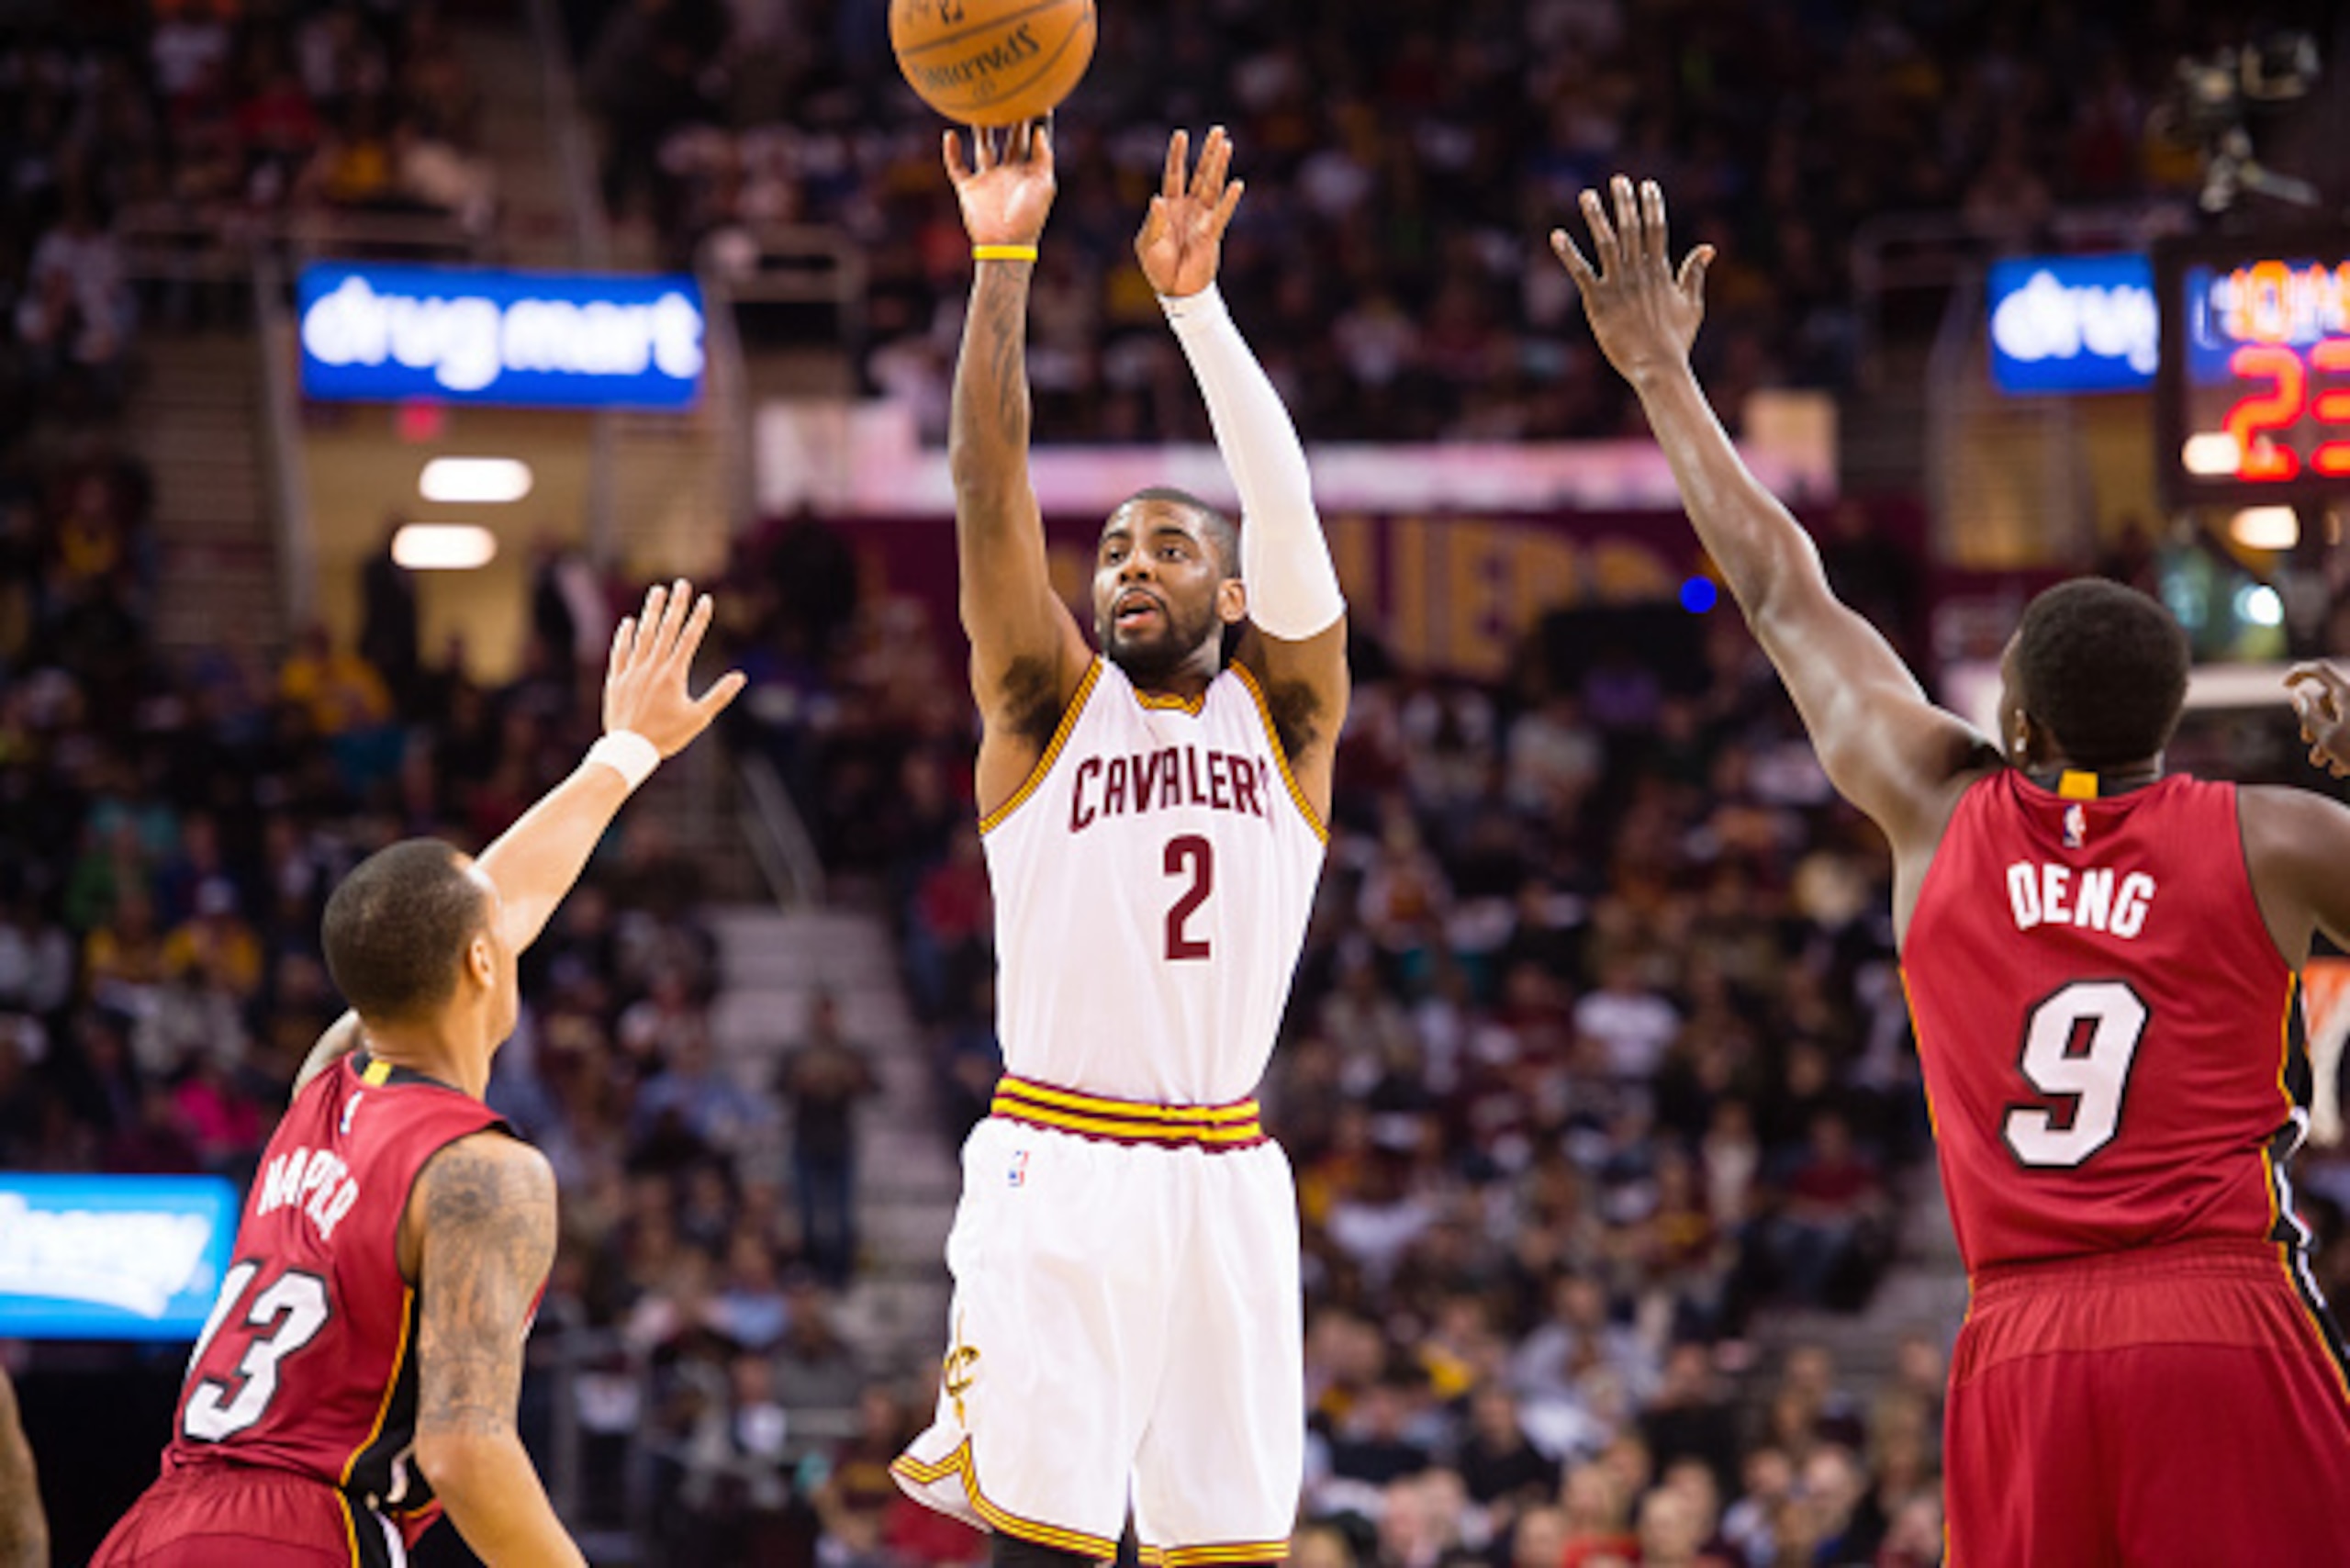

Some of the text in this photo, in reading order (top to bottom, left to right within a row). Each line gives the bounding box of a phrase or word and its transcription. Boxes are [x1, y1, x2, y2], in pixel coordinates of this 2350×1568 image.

[1163, 834, 1214, 961] 2
[2005, 859, 2156, 939] DENG
[2002, 979, 2149, 1169] 9
[183, 1259, 330, 1442] 13
